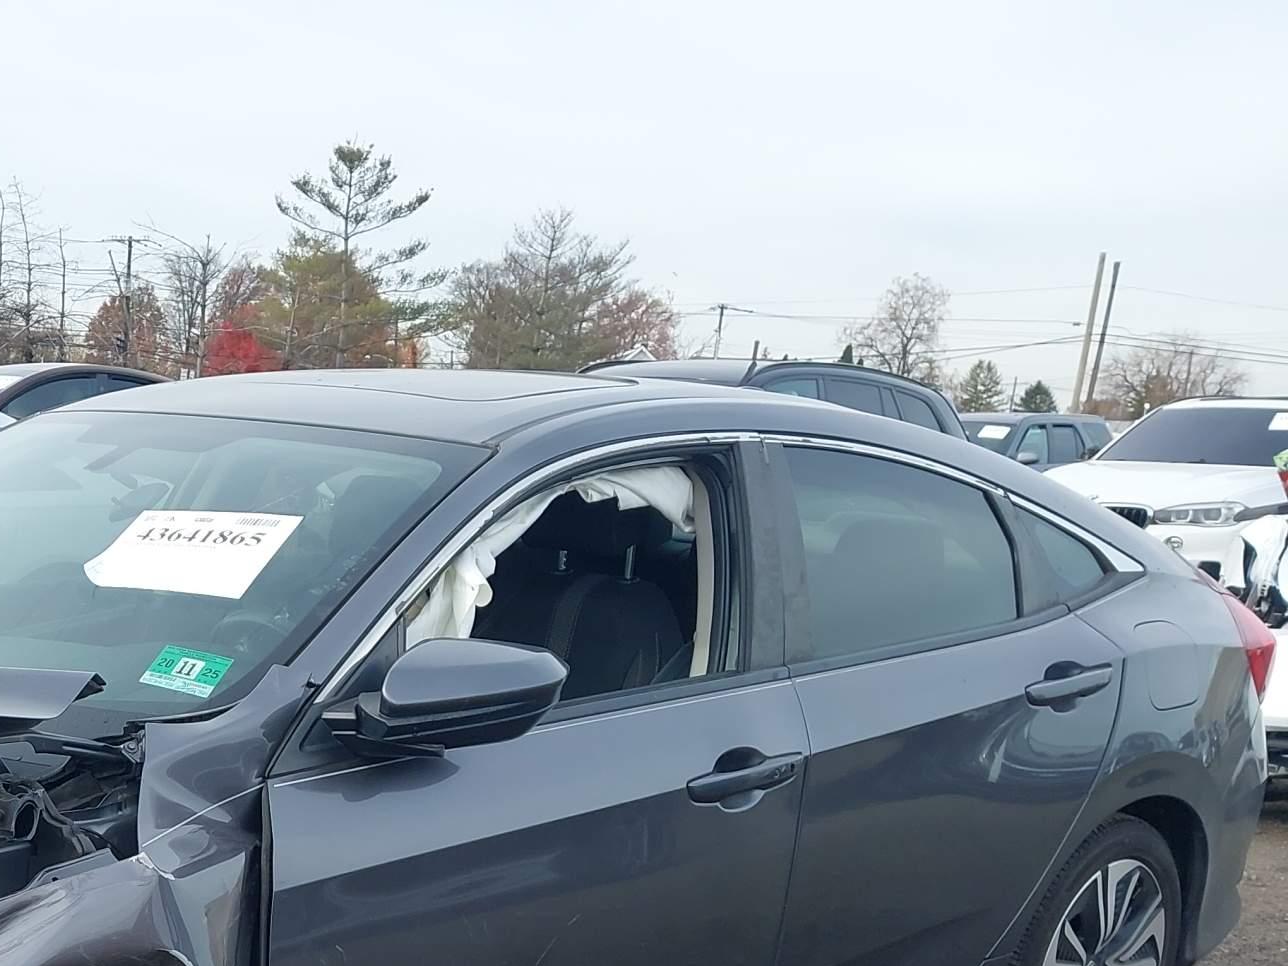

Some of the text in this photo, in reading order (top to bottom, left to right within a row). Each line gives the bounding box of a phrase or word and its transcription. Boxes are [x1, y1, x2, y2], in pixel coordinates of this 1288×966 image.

[137, 527, 267, 546] 43641865
[157, 657, 221, 680] 20 11 25
